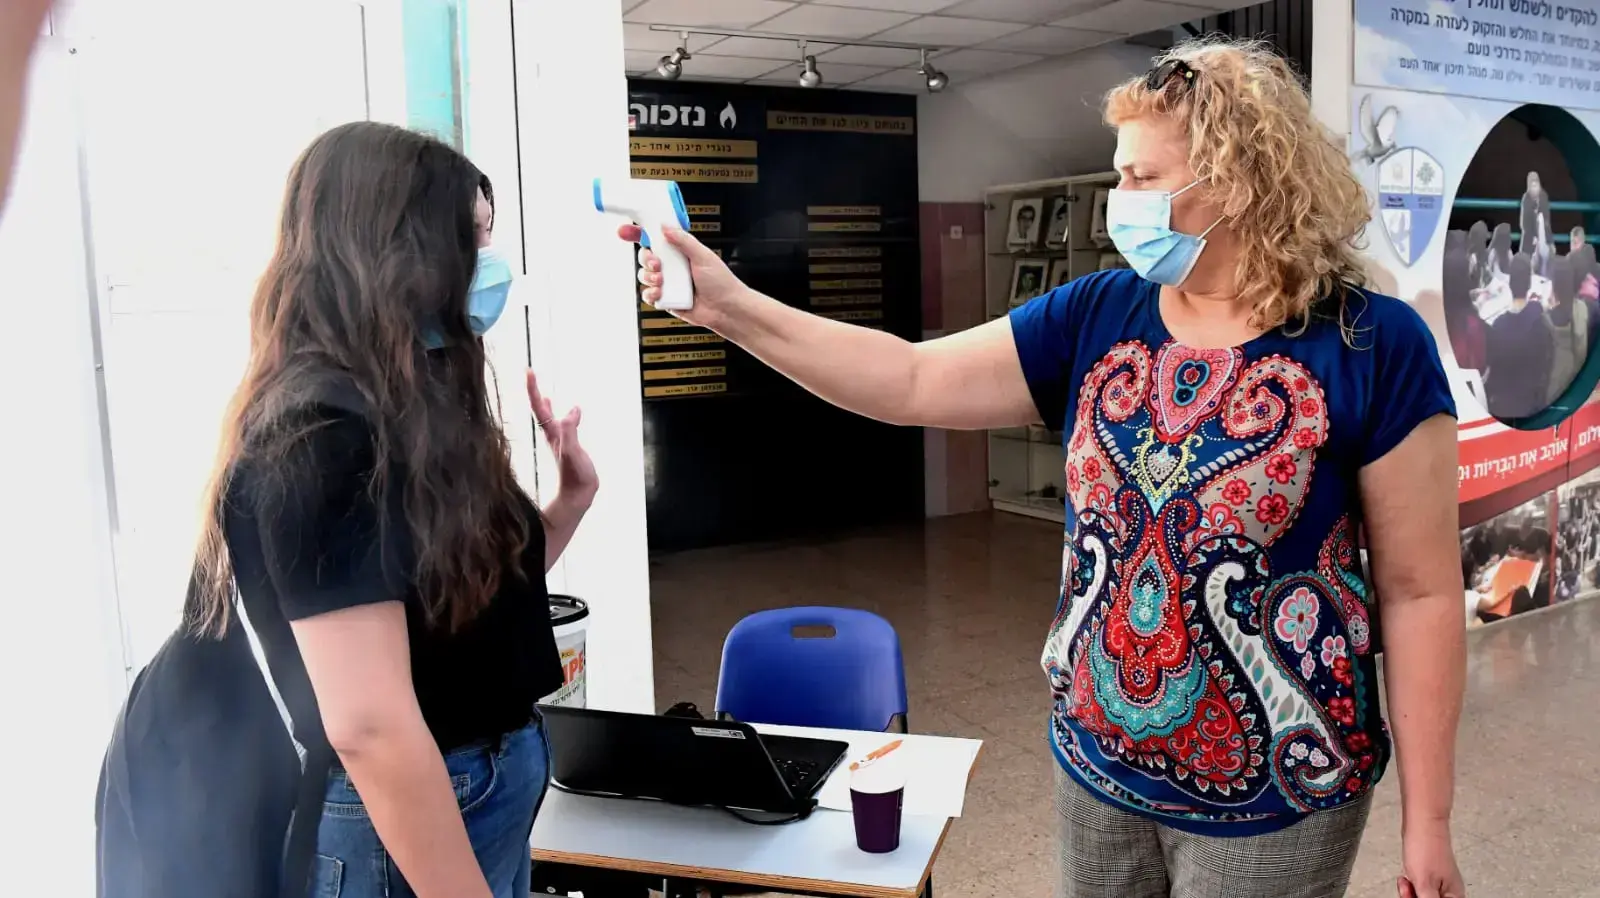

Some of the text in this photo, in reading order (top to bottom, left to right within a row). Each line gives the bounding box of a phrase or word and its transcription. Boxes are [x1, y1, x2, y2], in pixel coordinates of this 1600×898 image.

[1390, 7, 1430, 26] במקרה
[1557, 6, 1598, 26] להקדים
[1471, 20, 1506, 37] והזקוק
[1509, 25, 1538, 41] החלש
[1493, 45, 1521, 61] בדרכי
[1444, 62, 1464, 76] תיכון
[629, 103, 707, 127] נזכור
[671, 167, 695, 177] ישראל
